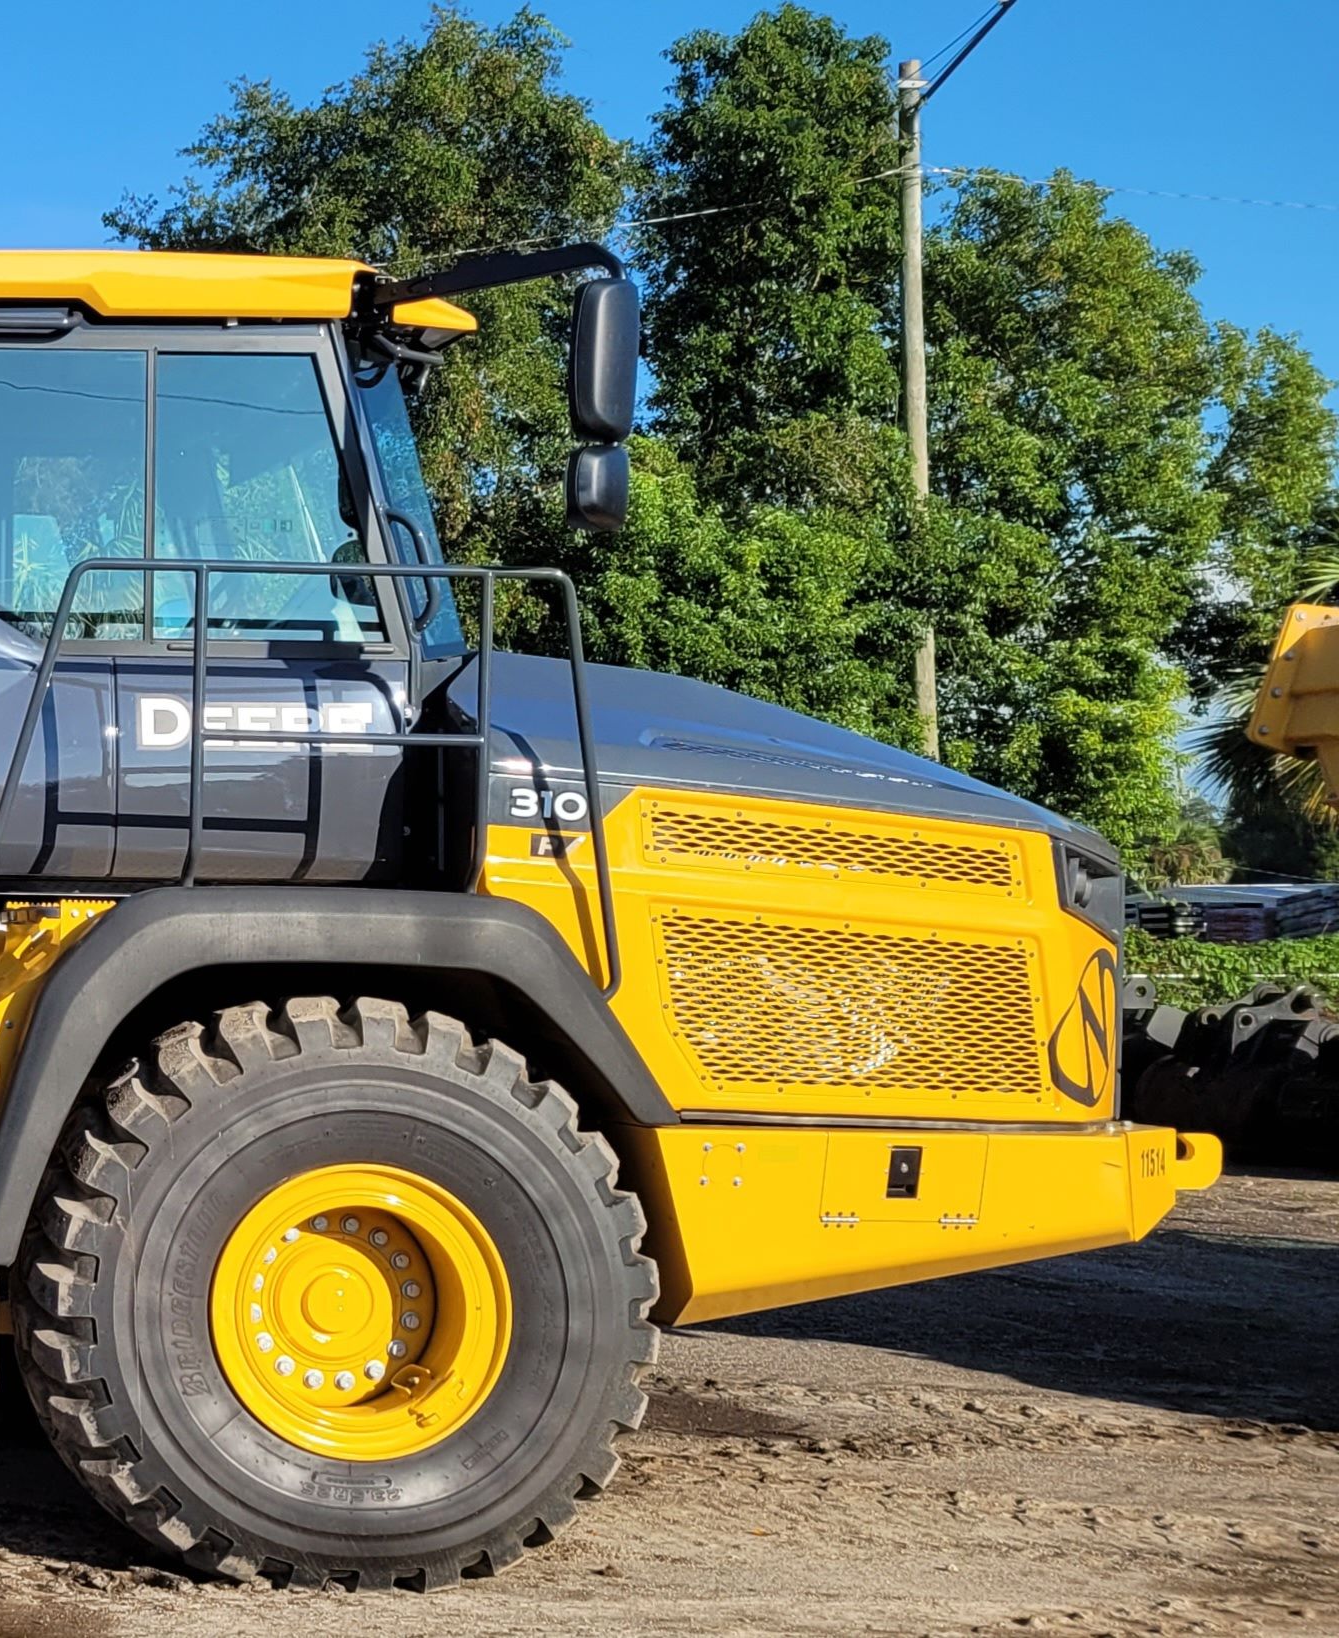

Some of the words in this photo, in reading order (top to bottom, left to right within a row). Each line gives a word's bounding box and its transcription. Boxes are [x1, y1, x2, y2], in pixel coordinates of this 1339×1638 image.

[136, 692, 374, 753] DEERE
[510, 788, 587, 821] 310
[1141, 1147, 1166, 1178] 11514
